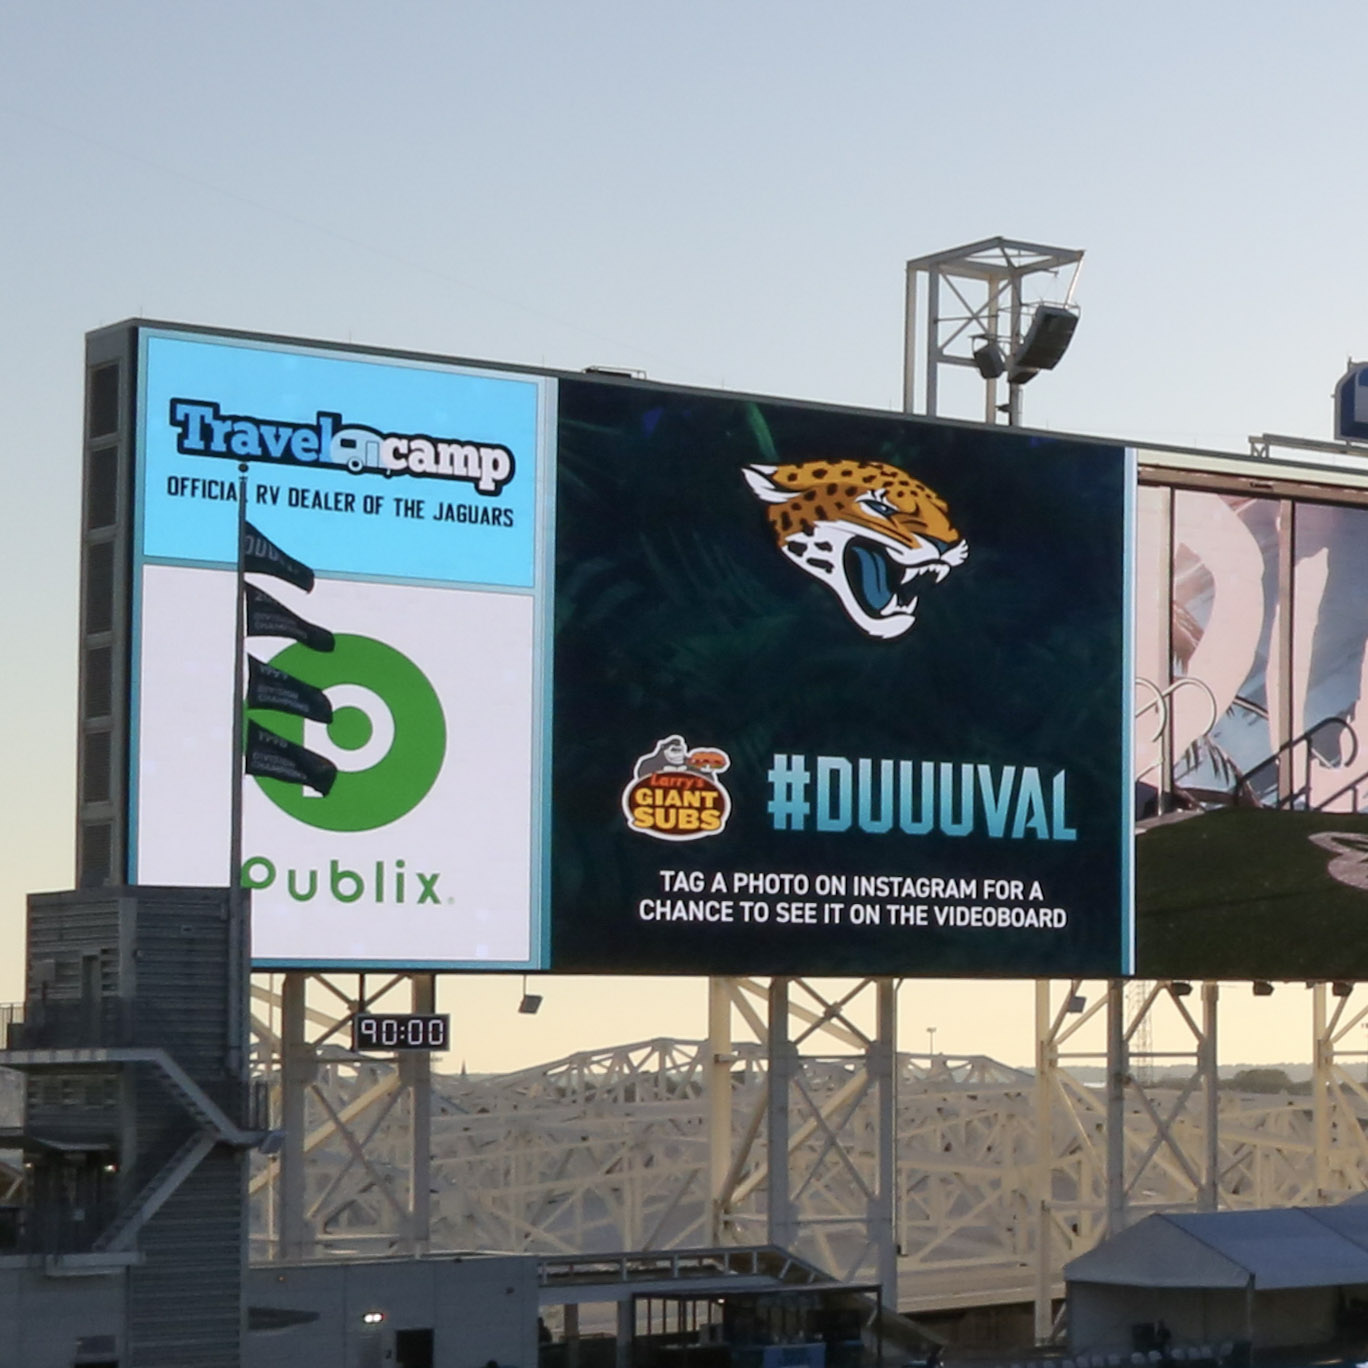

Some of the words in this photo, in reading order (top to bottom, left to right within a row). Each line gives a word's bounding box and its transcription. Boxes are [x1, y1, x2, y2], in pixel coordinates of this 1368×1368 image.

[167, 475, 248, 503] OFFICIA
[256, 484, 280, 506] RV
[288, 487, 356, 512] DEALER
[363, 495, 384, 515] OF
[394, 498, 425, 519] THE
[433, 502, 514, 527] JAGUARS
[634, 788, 718, 808] GIANT
[767, 753, 1077, 841] #DUUUVAL
[633, 807, 722, 830] SUBS
[241, 856, 442, 904] Publix
[660, 870, 705, 893] TAG
[711, 872, 727, 893] A
[734, 872, 809, 896] PHOTO
[816, 875, 847, 896] ON
[853, 876, 977, 900] INSTAGRAM
[984, 879, 1024, 901] FOR
[1029, 881, 1044, 901] A
[639, 900, 733, 922] CHANCE
[739, 902, 770, 923] TO
[776, 903, 817, 924] SEE
[824, 904, 843, 925] IT
[850, 904, 881, 925] ON
[886, 905, 929, 927] THE
[933, 906, 1067, 929] VIDEOBOARD
[361, 1019, 444, 1045] 90:00
